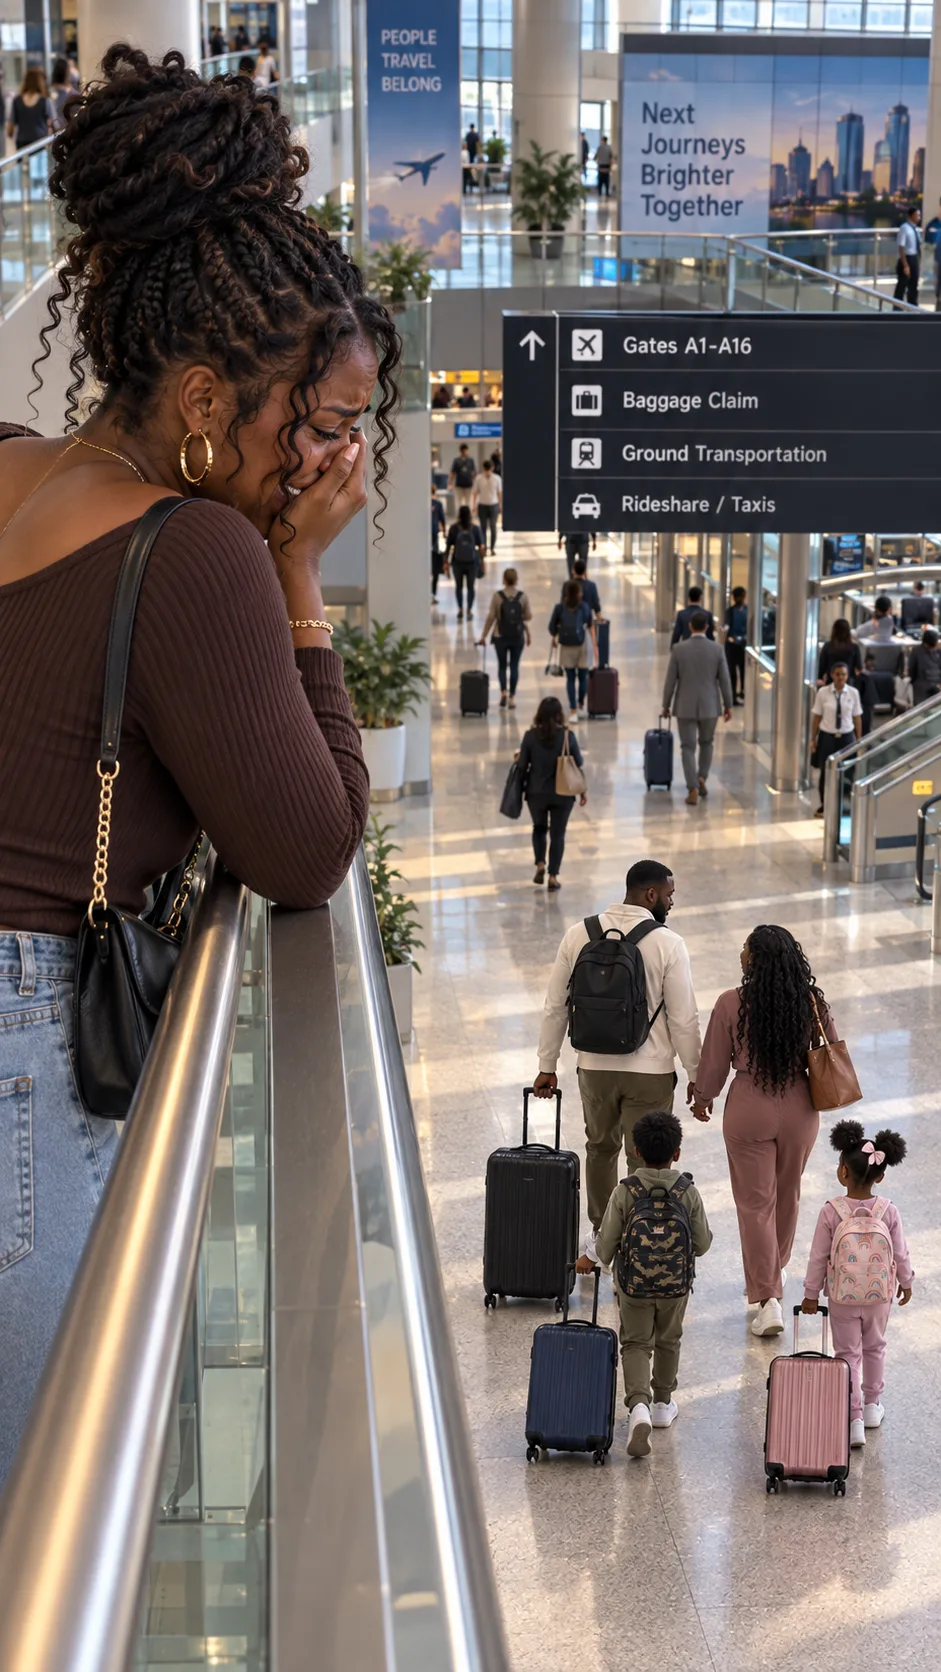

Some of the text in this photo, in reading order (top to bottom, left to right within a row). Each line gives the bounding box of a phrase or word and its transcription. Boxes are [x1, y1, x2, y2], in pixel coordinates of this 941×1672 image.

[381, 28, 437, 46] PEOPLE
[381, 52, 436, 69] TRAVEL
[381, 76, 441, 92] BELONG
[642, 102, 694, 124] Next
[641, 132, 745, 159] Journeys
[642, 163, 733, 189] Brighter
[641, 195, 743, 221] Together
[623, 336, 752, 354] Gates A1-A16
[623, 391, 759, 413] Baggage Claim
[622, 445, 827, 466] Ground Transportation
[622, 495, 776, 515] Rideshare / Taxis
